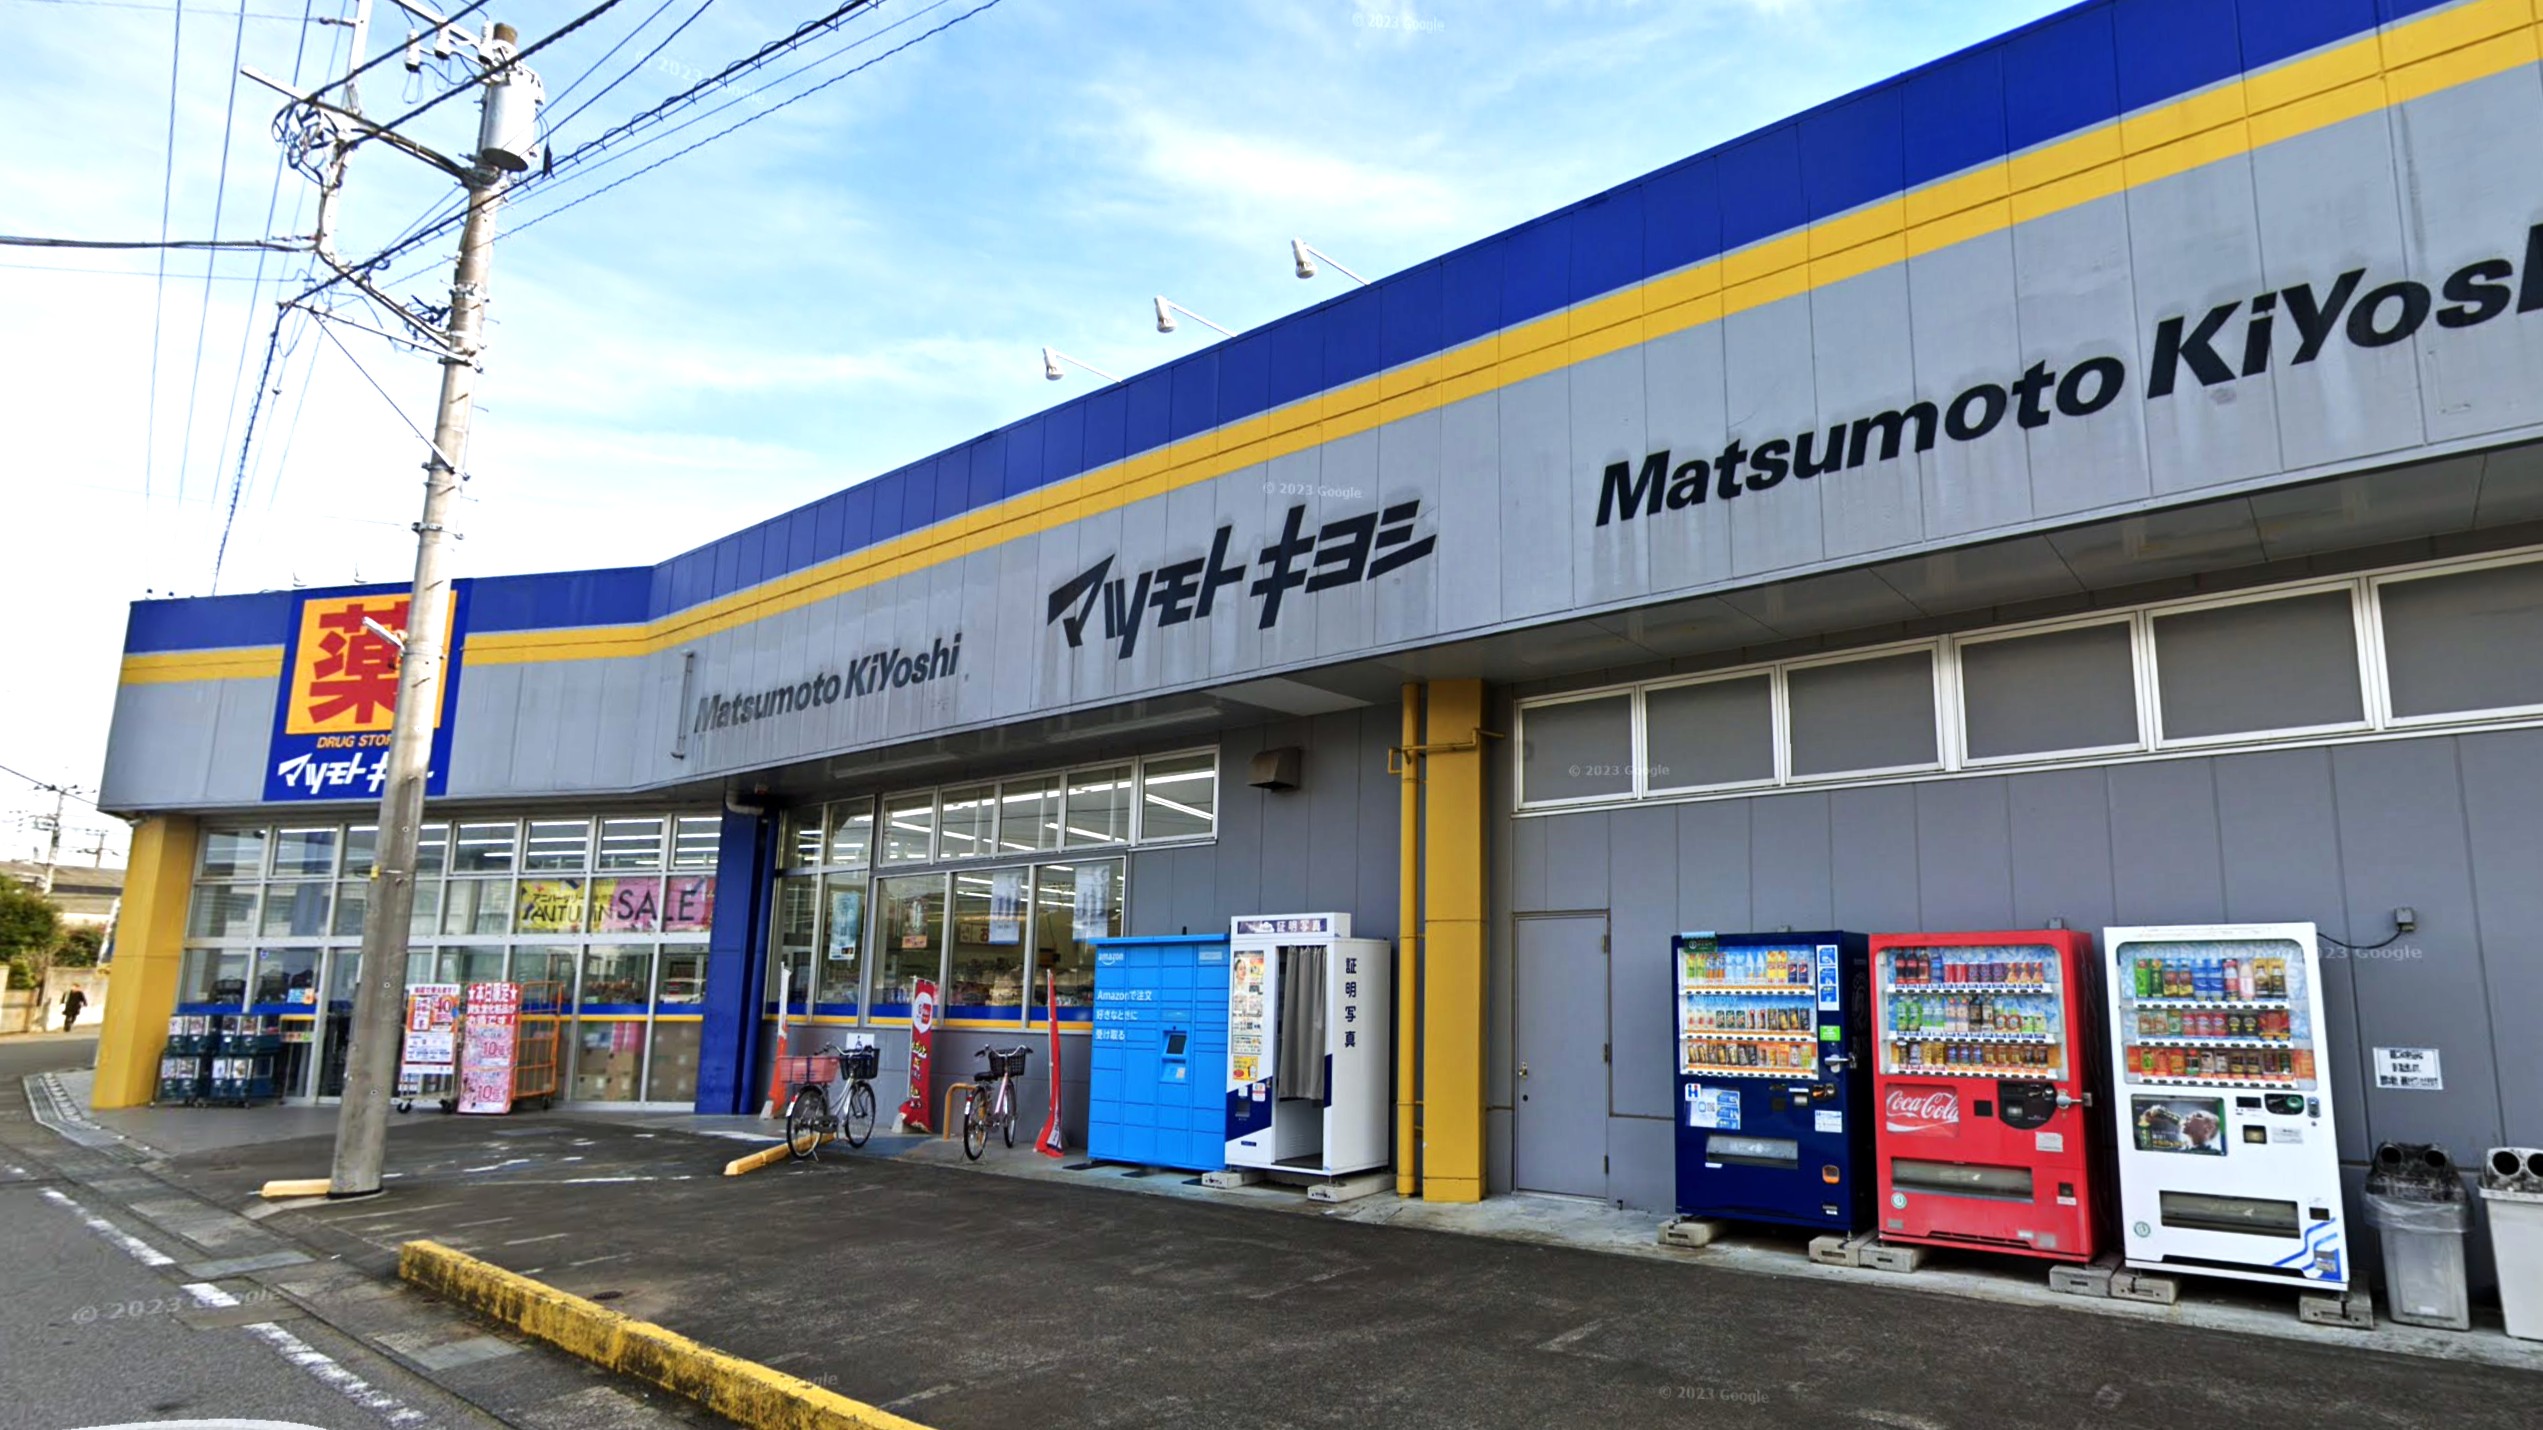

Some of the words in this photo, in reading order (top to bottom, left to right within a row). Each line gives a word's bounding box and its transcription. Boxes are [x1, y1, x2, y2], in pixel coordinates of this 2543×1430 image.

[1595, 355, 2126, 527] Matsumoto
[1047, 499, 1438, 661] マツモトキヨシ
[308, 601, 412, 725] 薬
[693, 672, 841, 733] Matsumoto
[843, 632, 963, 699] KiYoshi
[316, 735, 355, 749] DRUG
[357, 734, 393, 747] STOR
[1098, 952, 1125, 963] amazon
[1276, 919, 1322, 933] 証明写真
[1097, 990, 1152, 1001] Amazonで注文
[1344, 957, 1358, 1048] 証明写真
